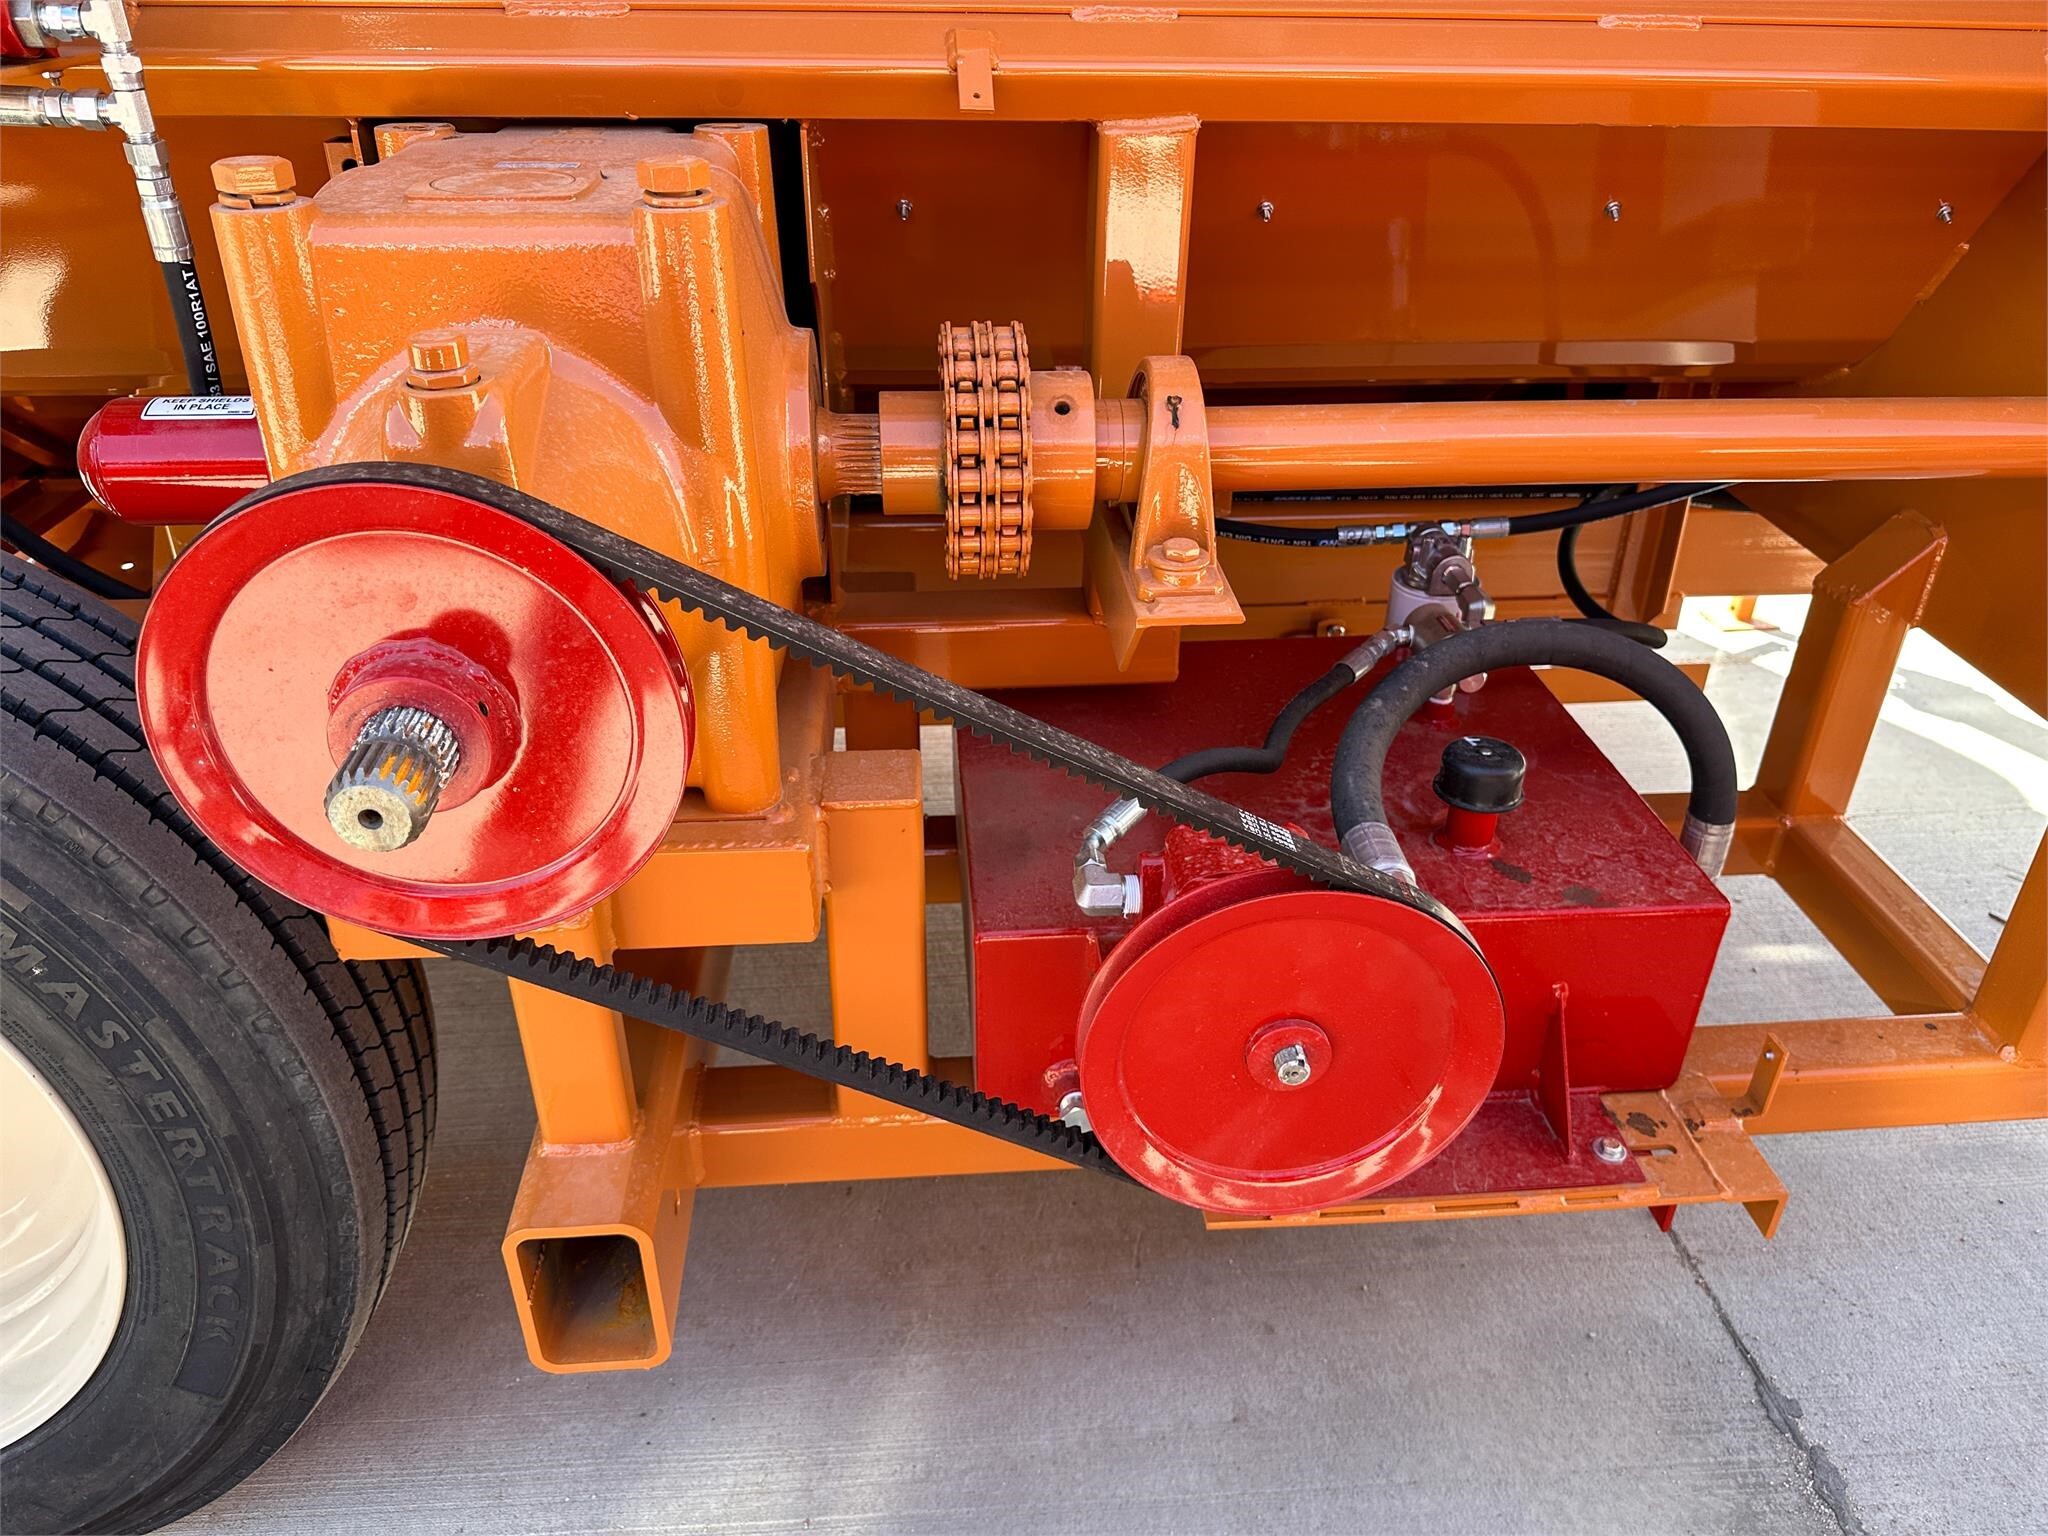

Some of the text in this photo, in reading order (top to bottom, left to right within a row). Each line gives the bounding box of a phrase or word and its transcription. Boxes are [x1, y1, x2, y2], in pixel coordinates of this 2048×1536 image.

[181, 269, 209, 338] 100R1AT
[200, 341, 217, 373] SAE
[189, 403, 231, 411] PLACE
